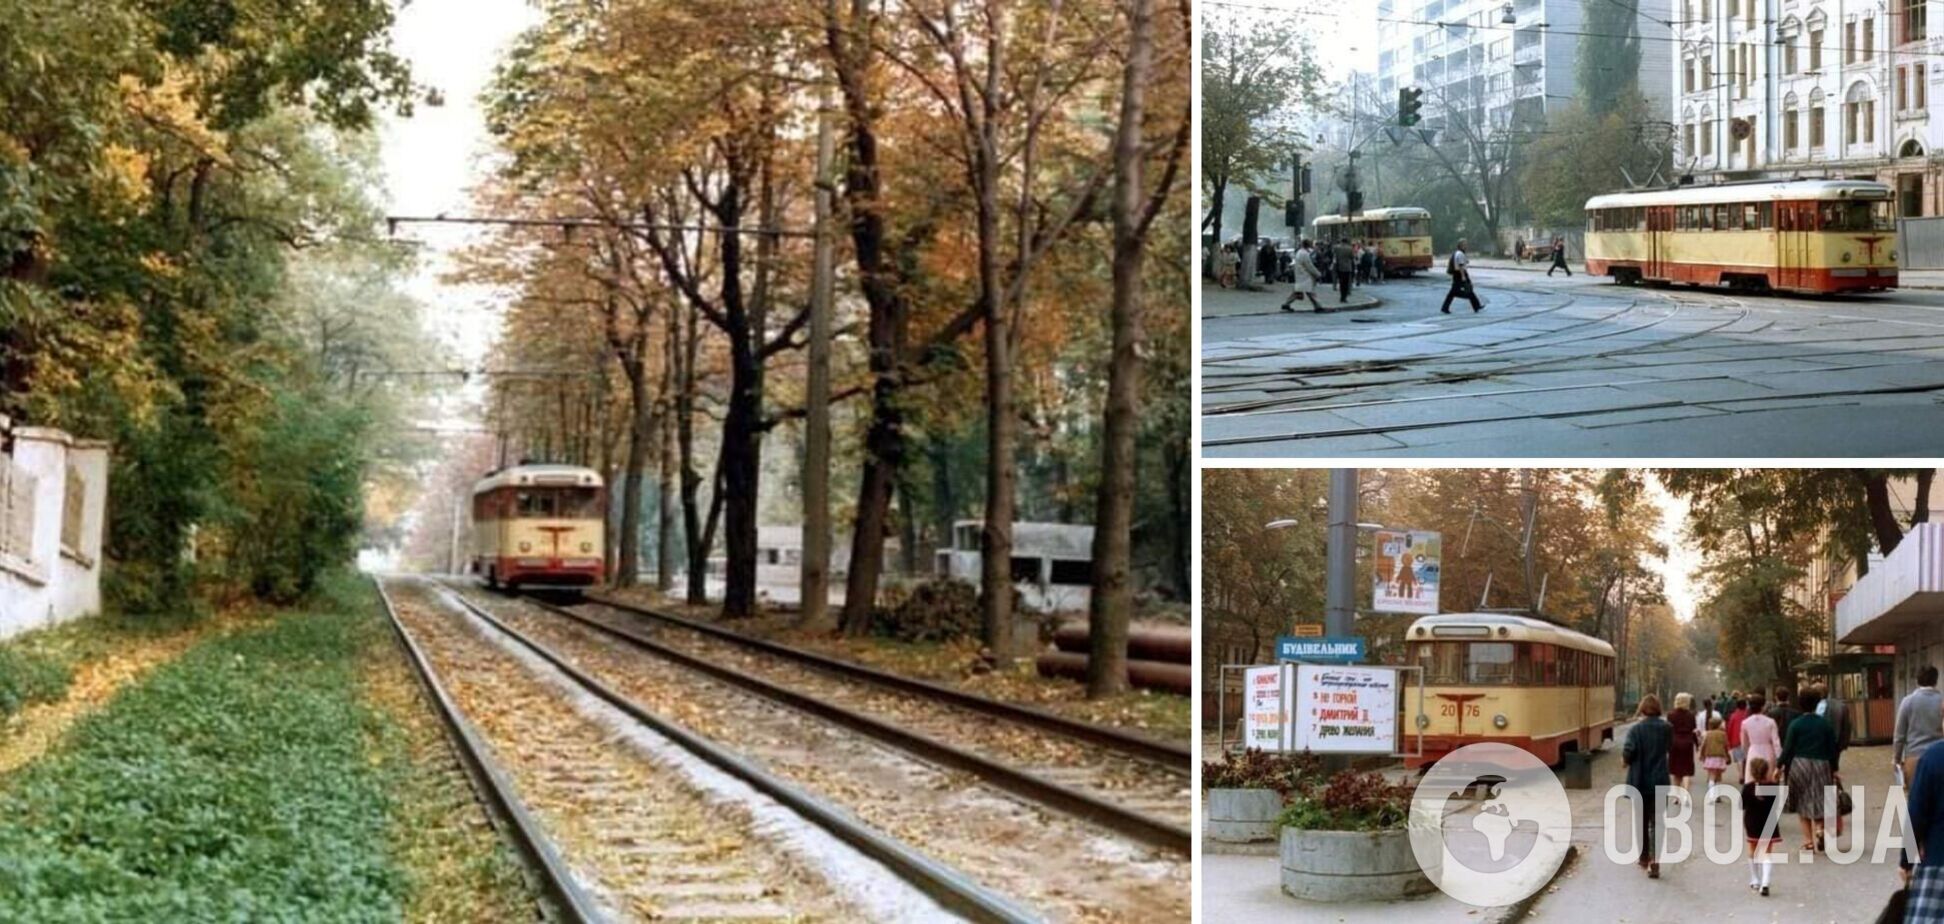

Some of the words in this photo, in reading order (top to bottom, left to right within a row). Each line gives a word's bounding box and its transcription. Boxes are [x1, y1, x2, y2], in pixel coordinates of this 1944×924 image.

[1282, 643, 1358, 655] БУДІВЕЛЬНИК
[1319, 706, 1358, 721] ДМИТРИЙ
[1343, 726, 1375, 737] ЖЕЛАНИЯ
